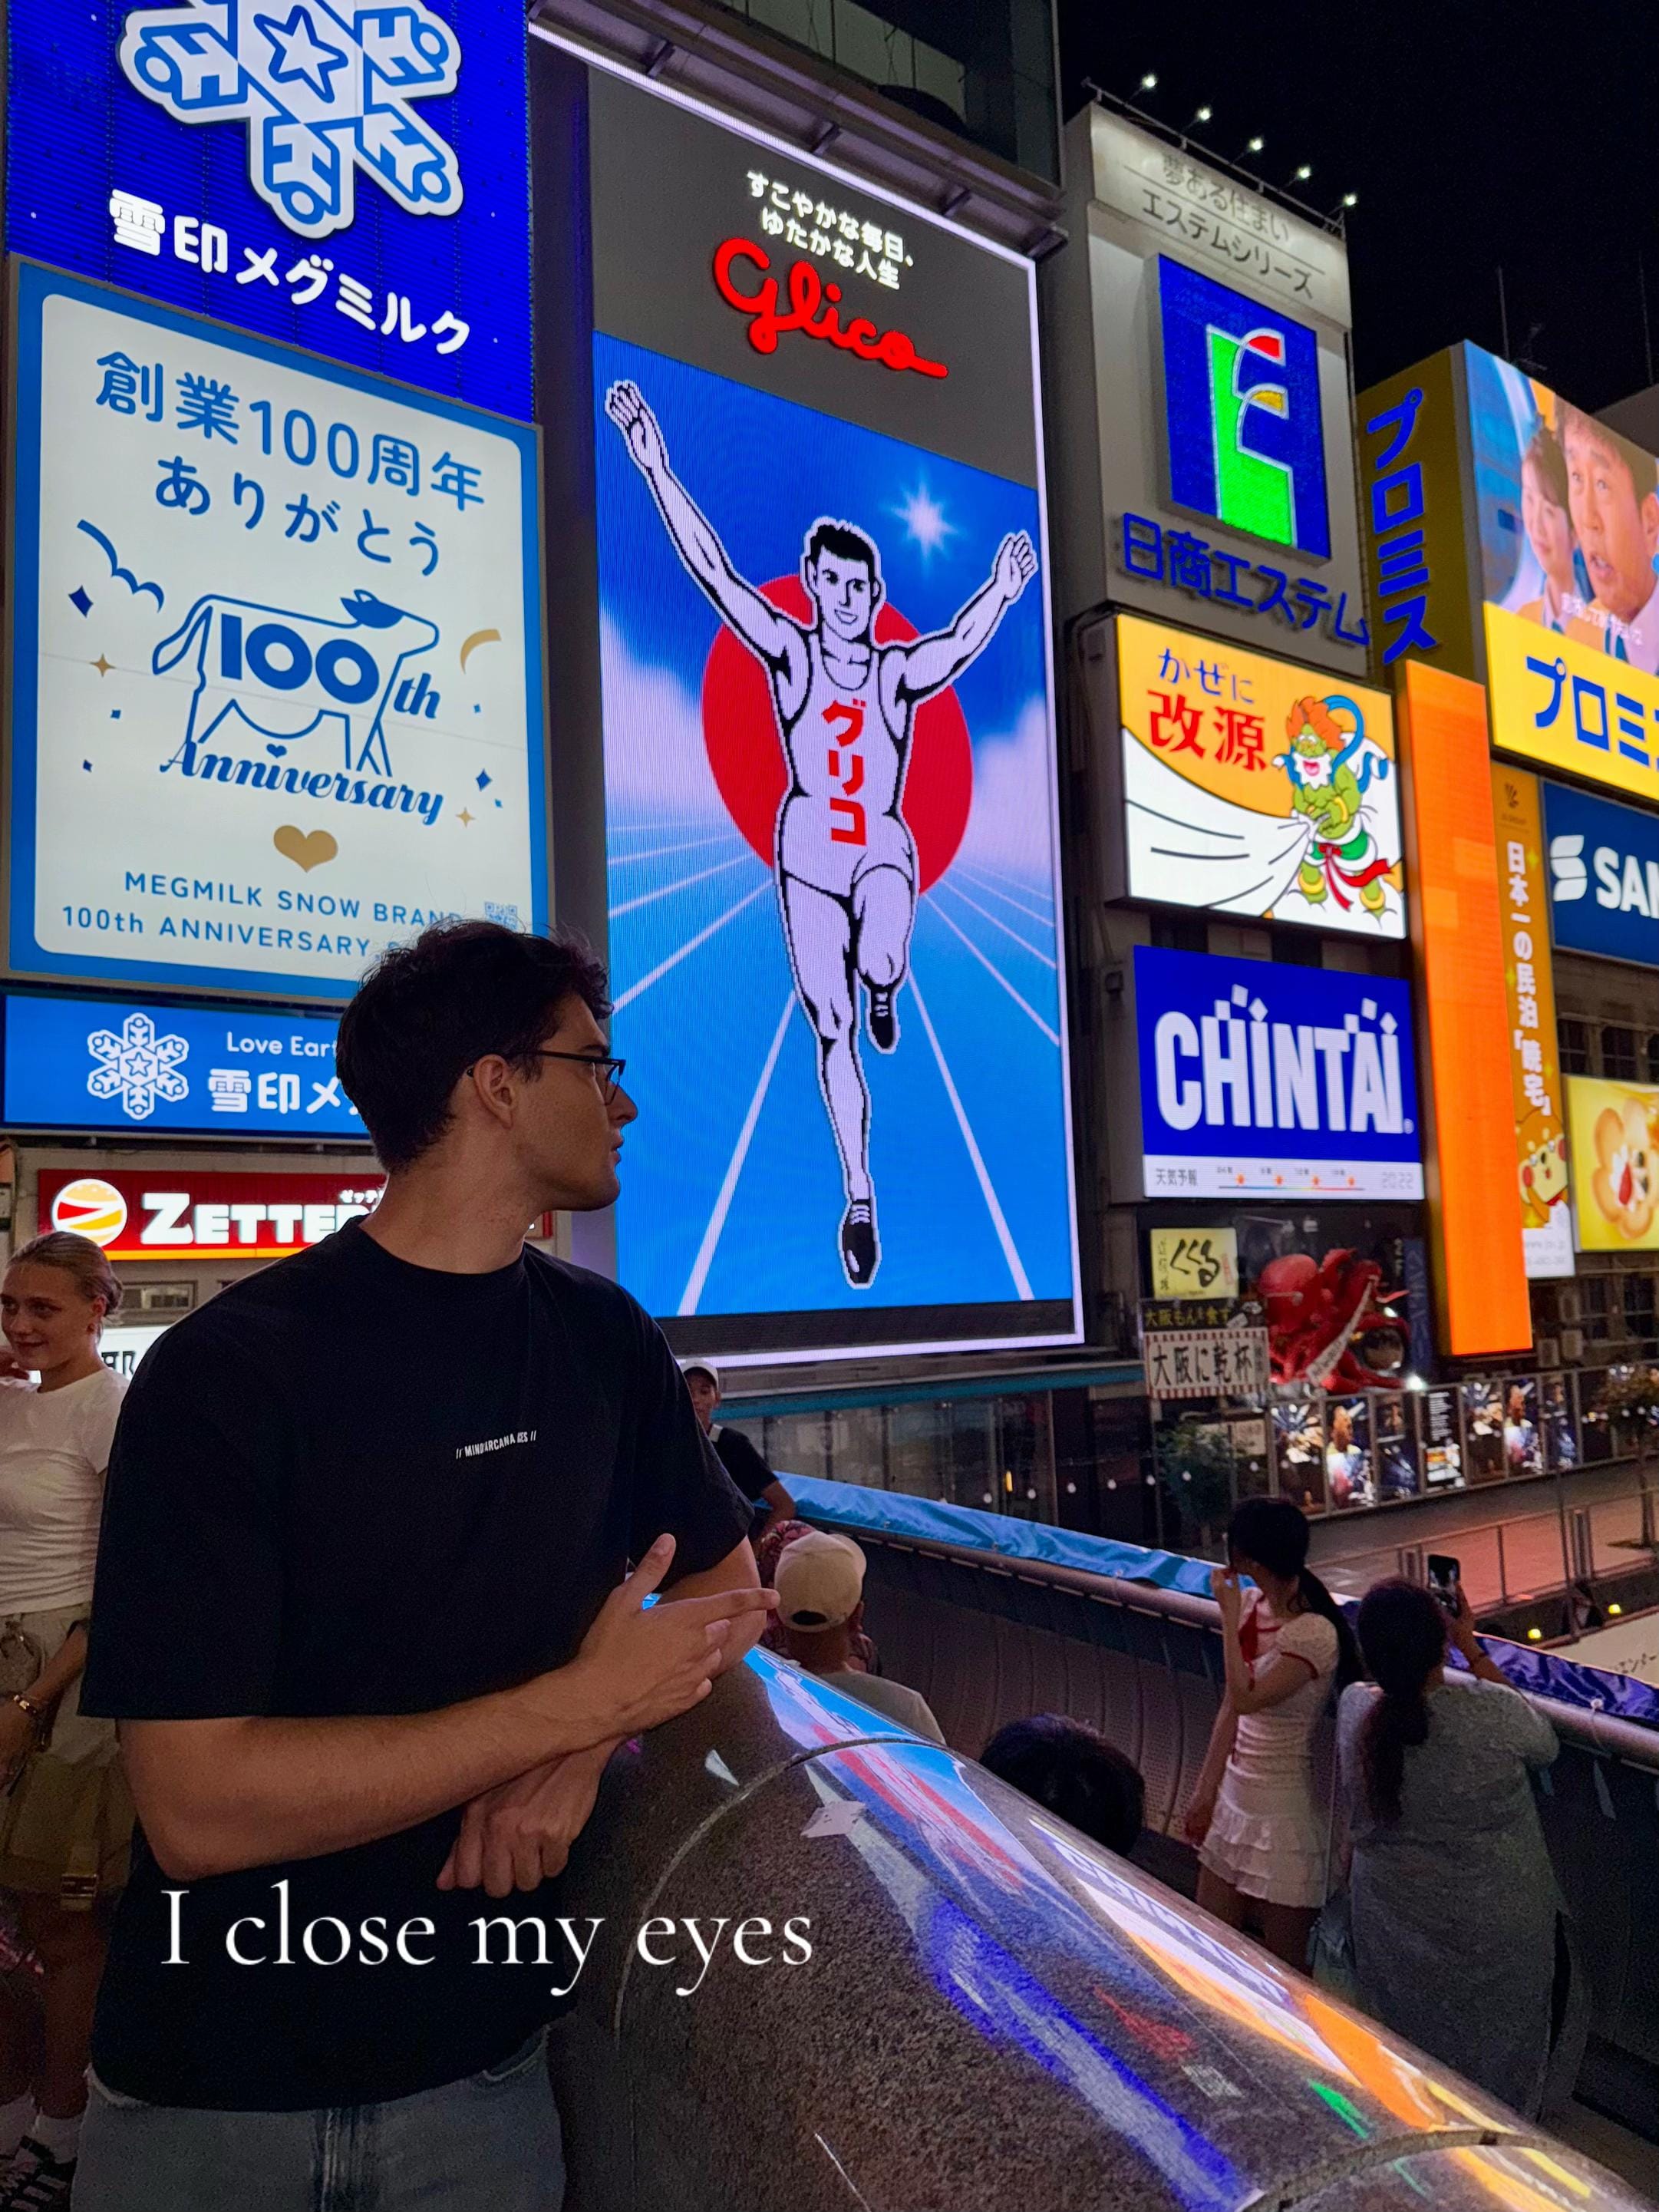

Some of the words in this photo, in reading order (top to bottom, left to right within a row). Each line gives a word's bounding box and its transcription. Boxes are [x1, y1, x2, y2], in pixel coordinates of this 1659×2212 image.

[109, 189, 470, 355] 雪印メグミルク
[761, 207, 900, 290] ゆたかな人生
[713, 237, 949, 378] Glico
[96, 351, 485, 511] 創業100周年
[155, 456, 439, 576] ありがとう
[1367, 387, 1437, 665] プロミス
[1123, 513, 1370, 646] 日商エステム
[1159, 649, 1255, 705] かぜに
[1525, 655, 1659, 770] プロミ
[1147, 689, 1268, 771] 改源
[160, 741, 444, 825] Anniversary
[822, 698, 867, 847] グリコ
[62, 906, 144, 934] 100th
[160, 916, 370, 956] ANNIVERSARY
[125, 871, 262, 907] MEGMILK
[278, 890, 361, 919] SNOW
[227, 1032, 283, 1055] Love
[1155, 984, 1404, 1134] CHINTAI
[208, 1068, 358, 1115] 雪印メ
[1170, 1239, 1221, 1288] くくる
[1153, 1341, 1253, 1386] 大阪に乾杯
